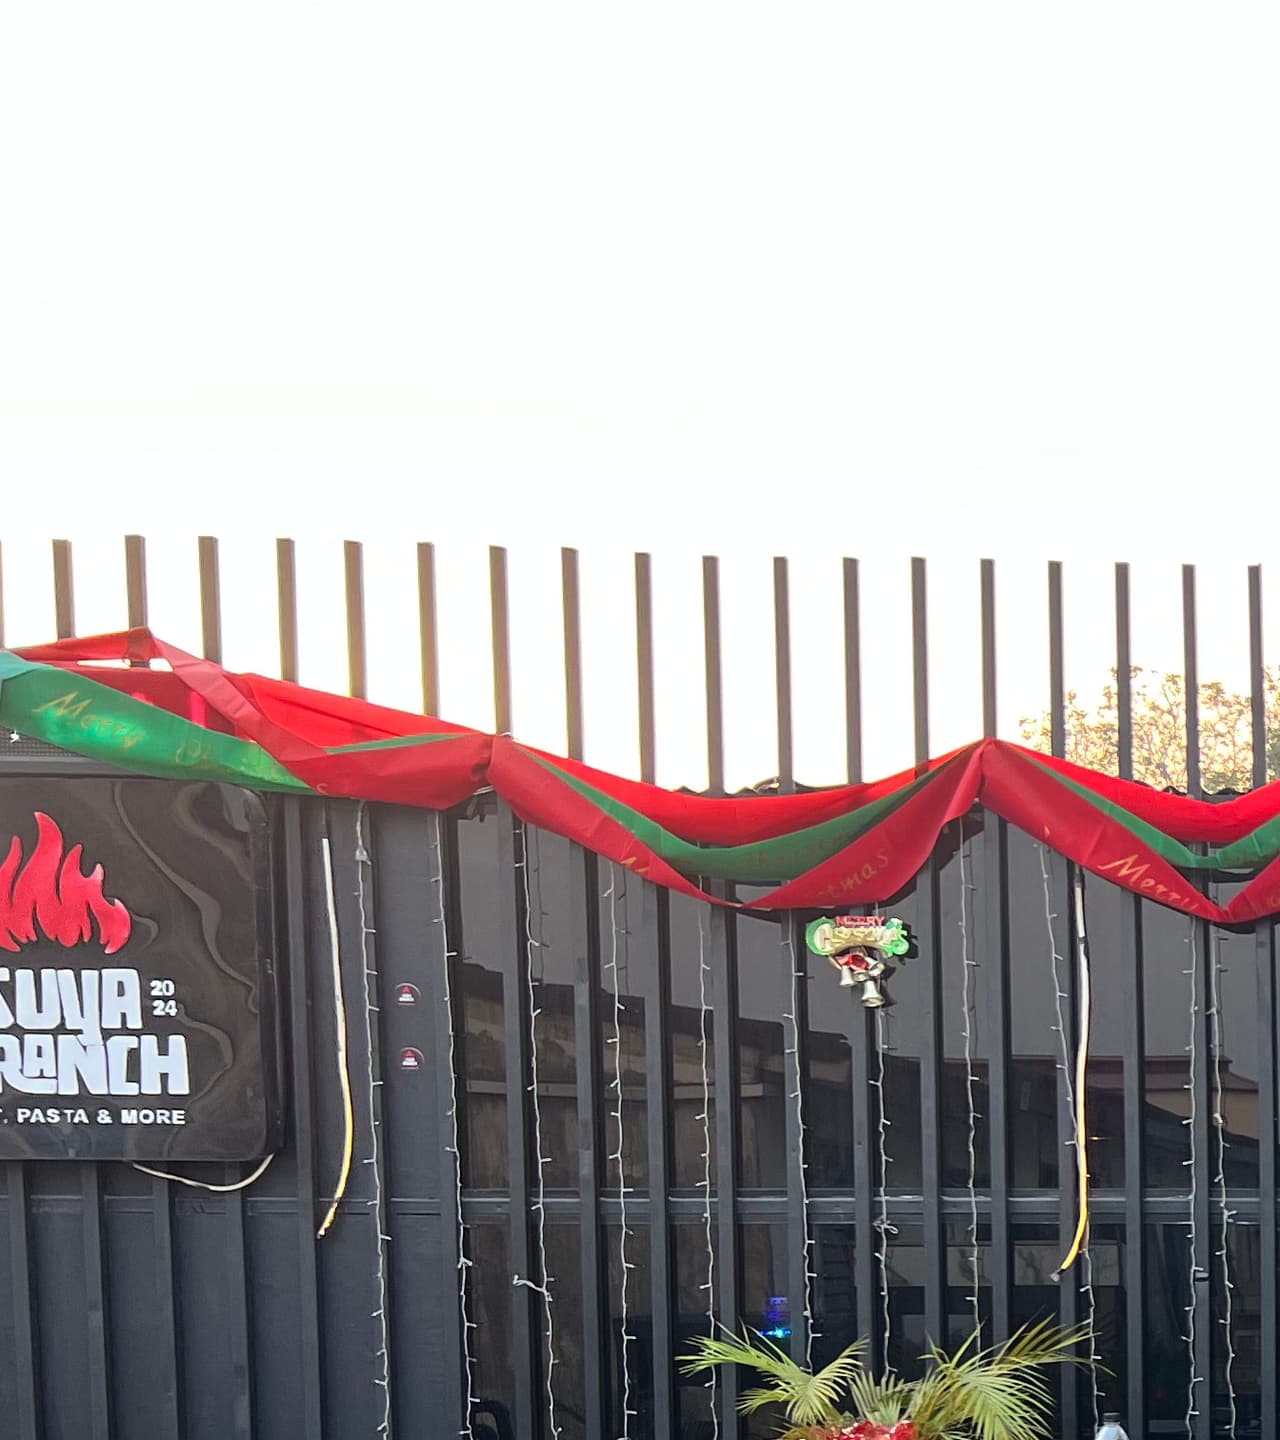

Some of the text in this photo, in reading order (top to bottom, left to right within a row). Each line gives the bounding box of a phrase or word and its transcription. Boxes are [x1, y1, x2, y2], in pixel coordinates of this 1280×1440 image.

[150, 980, 175, 996] 20
[152, 1000, 178, 1016] 24
[17, 1108, 89, 1124] PASTA
[97, 1109, 112, 1124] &
[121, 1110, 186, 1125] MORE
